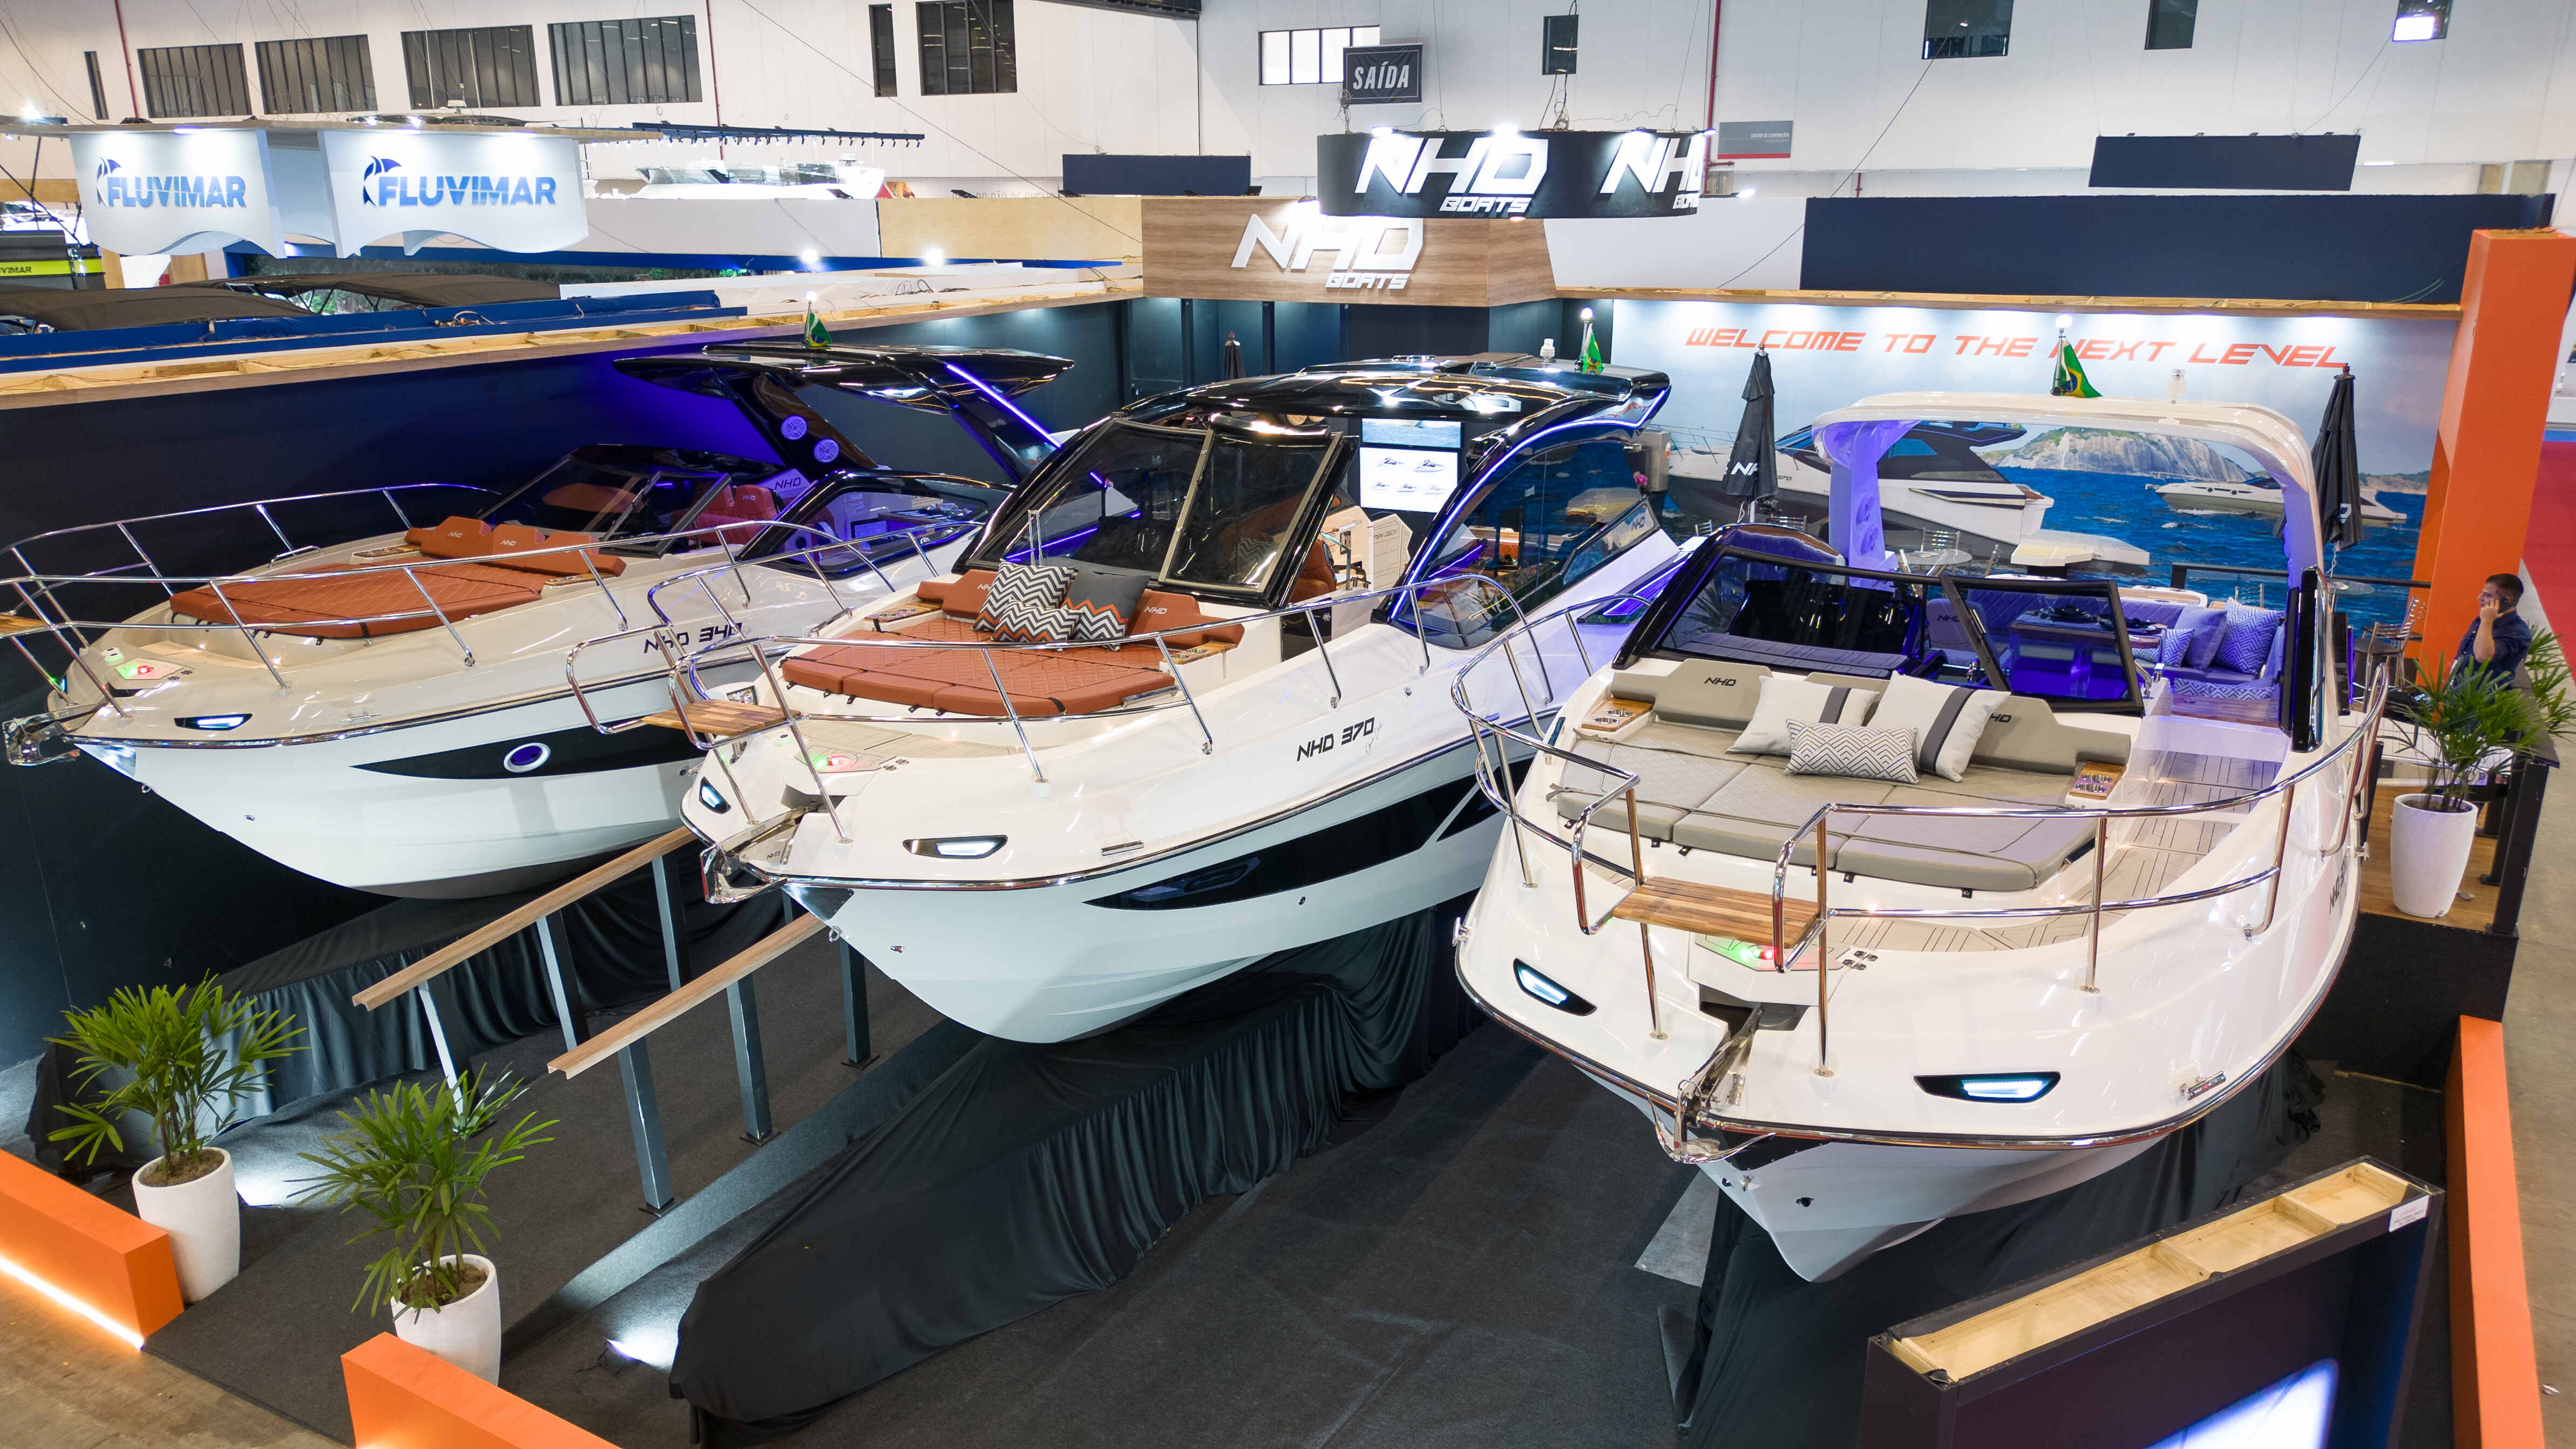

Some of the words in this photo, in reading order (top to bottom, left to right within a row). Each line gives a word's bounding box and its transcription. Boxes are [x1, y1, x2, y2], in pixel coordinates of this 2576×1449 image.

[1353, 61, 1409, 90] SAÍDA
[1355, 138, 1549, 195] NHD
[106, 175, 247, 208] FLUVIMAR
[378, 176, 557, 206] FLUVIMAR
[1439, 197, 1532, 213] BOATS
[1231, 214, 1423, 270] NHD
[1325, 273, 1410, 289] BOATS
[1685, 328, 1866, 351] WELCOME
[1884, 334, 1937, 354] TO
[1955, 335, 2038, 357] THE
[2187, 343, 2348, 368] LEVEL
[775, 477, 801, 490] NHD
[1144, 606, 1168, 615] NHD
[1704, 677, 1737, 686] NHD
[1297, 733, 1334, 762] NHD
[1341, 717, 1375, 745] 370
